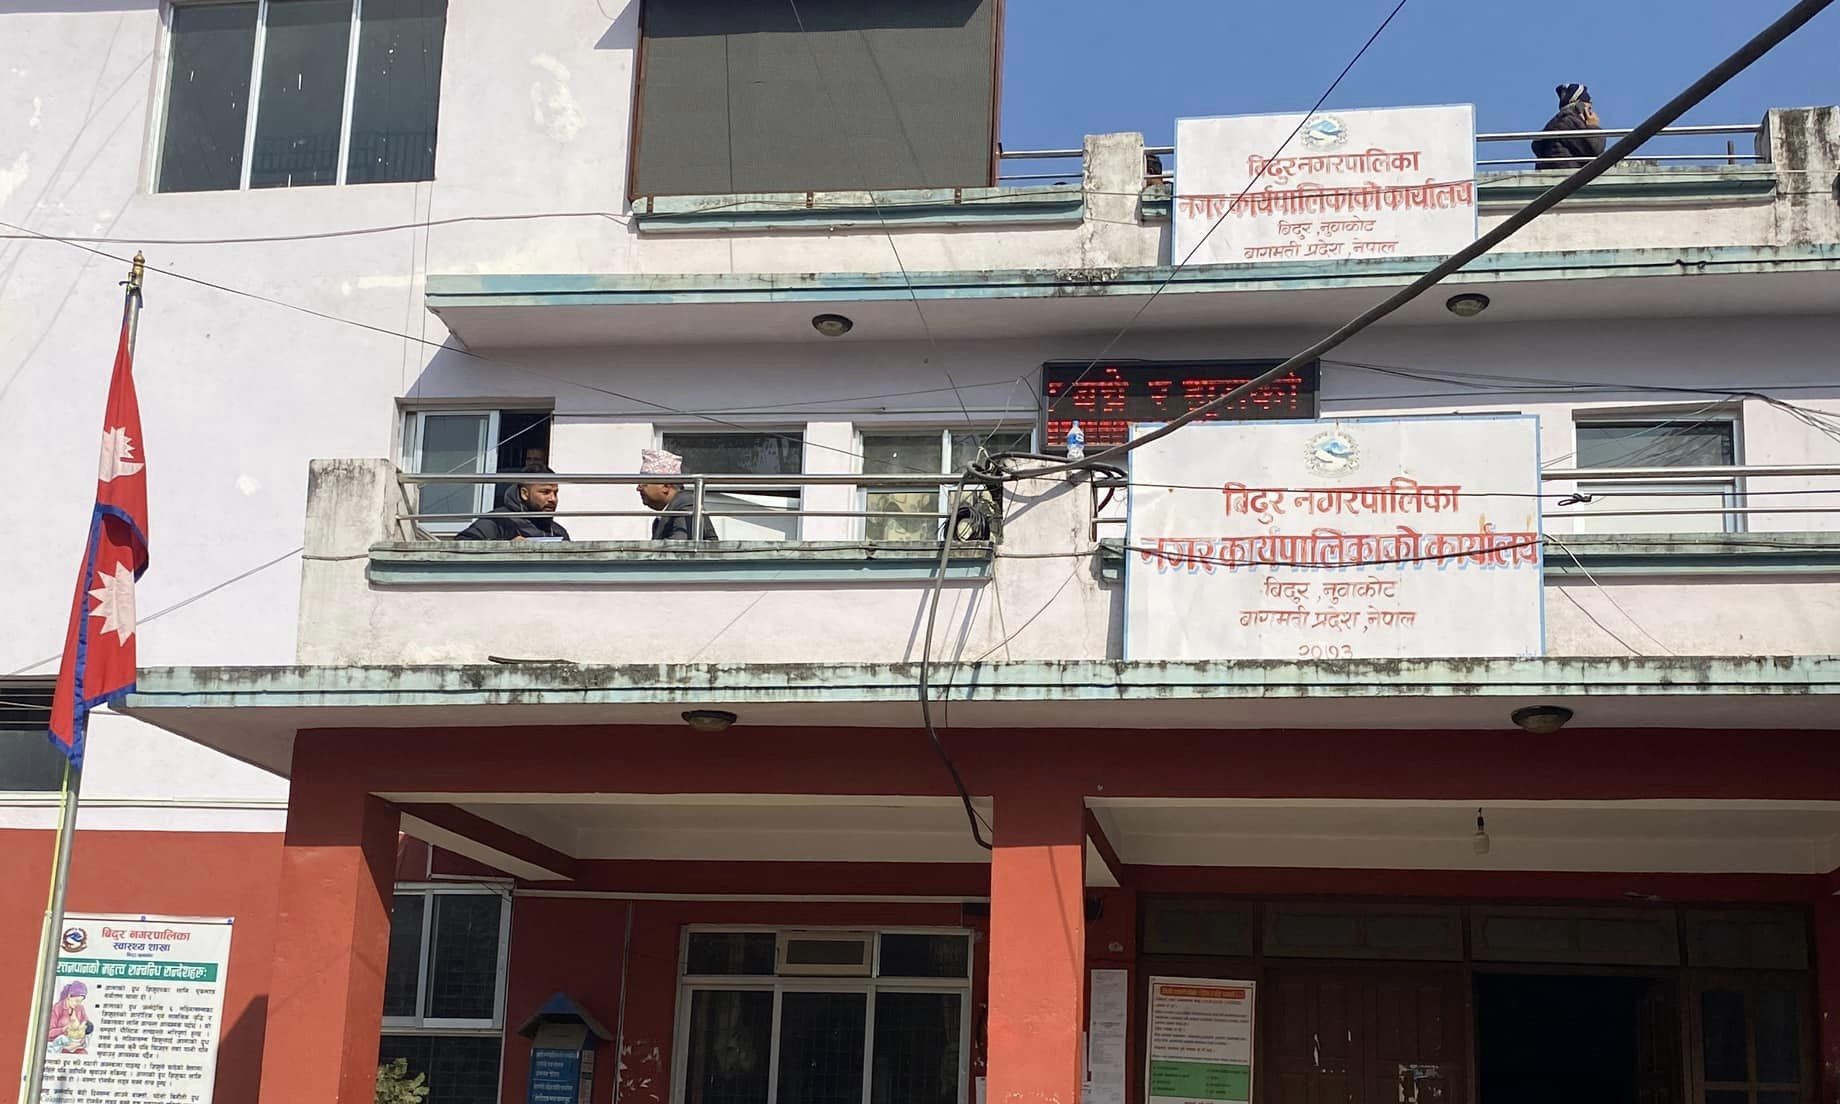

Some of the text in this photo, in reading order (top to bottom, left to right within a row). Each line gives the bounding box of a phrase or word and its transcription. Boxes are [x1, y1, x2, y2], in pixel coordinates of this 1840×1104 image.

[1178, 193, 1229, 219] नगर
[1277, 219, 1313, 241] बिदुर
[1243, 241, 1301, 259] बागमती
[1222, 476, 1462, 524] बिदुर नगरपालिका
[1140, 536, 1218, 573] नगर
[1424, 522, 1539, 568] कार्यालय
[1264, 576, 1311, 604] बिदुर
[1239, 606, 1310, 628] बागमती
[1311, 607, 1360, 633] प्रदेश
[101, 926, 191, 942] बिदुर नगरपालिका
[112, 941, 171, 952] स्वास्थ्य शाखा
